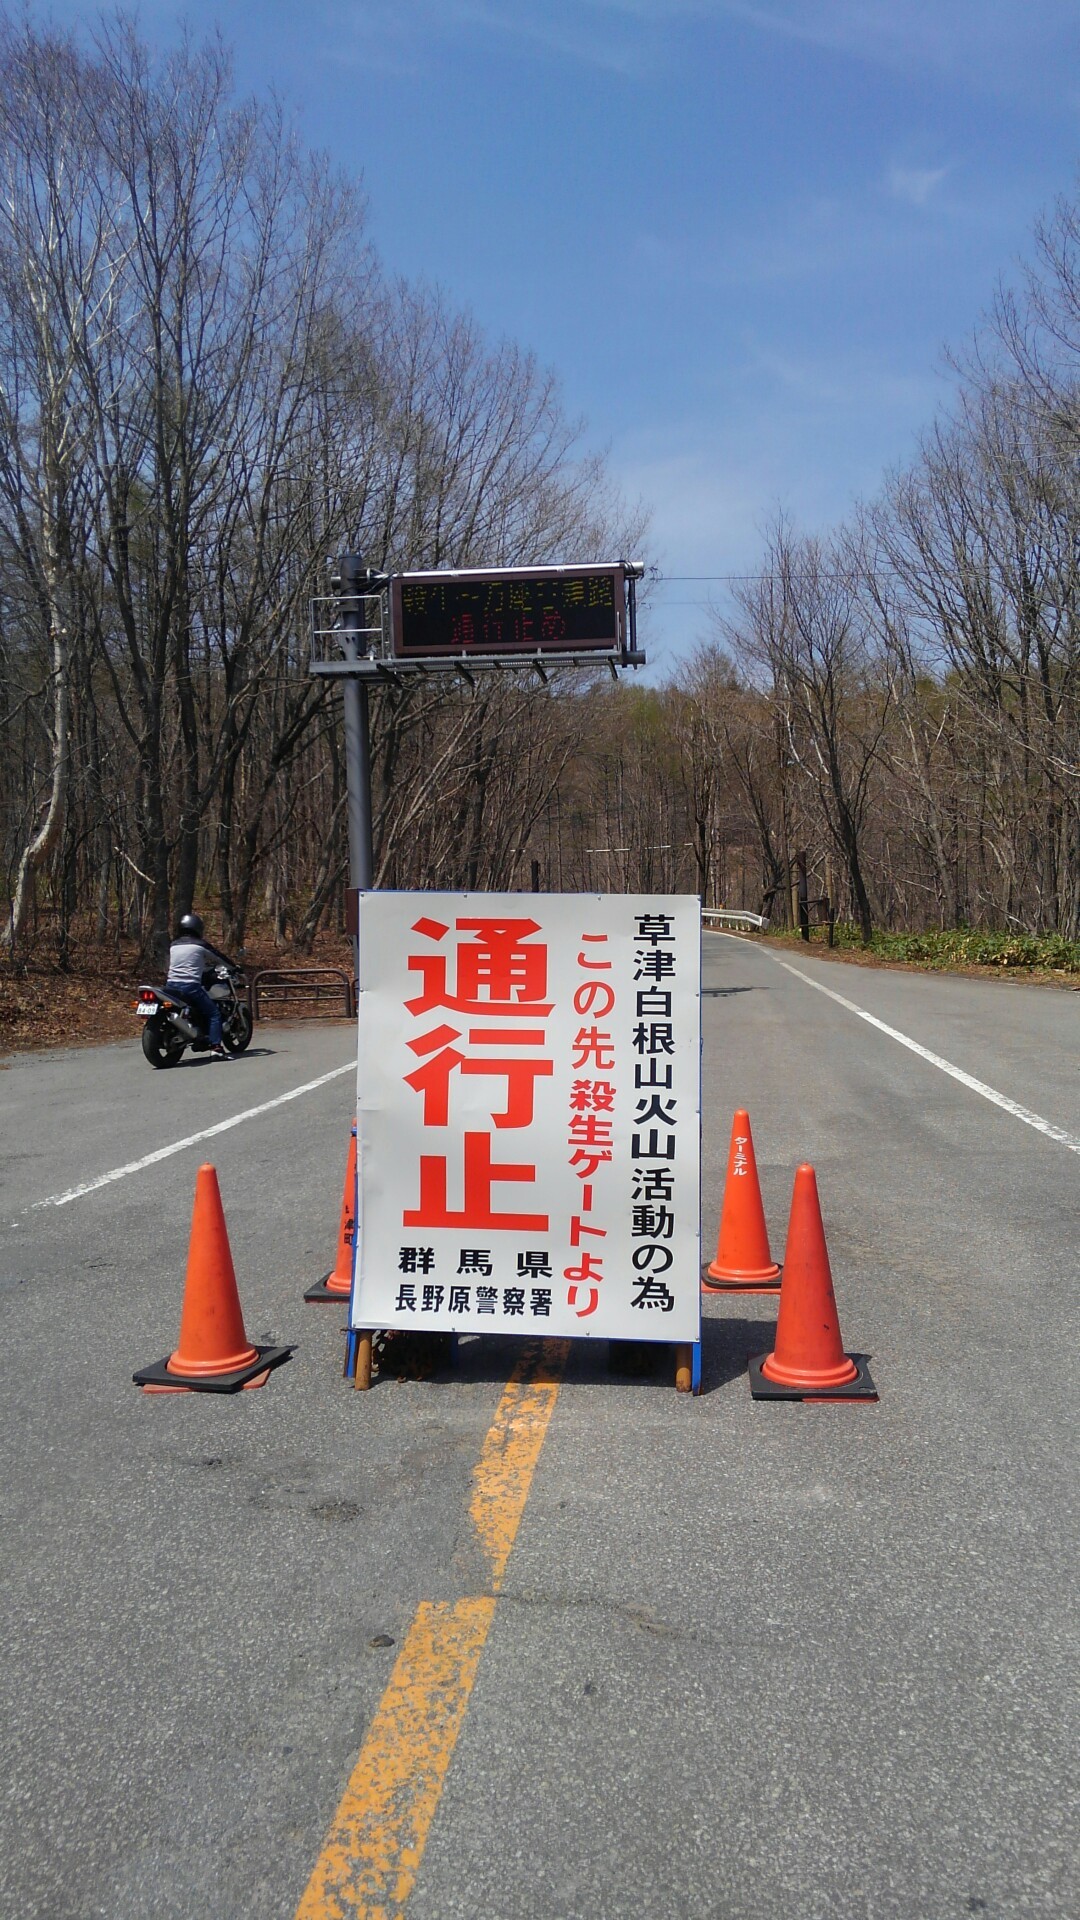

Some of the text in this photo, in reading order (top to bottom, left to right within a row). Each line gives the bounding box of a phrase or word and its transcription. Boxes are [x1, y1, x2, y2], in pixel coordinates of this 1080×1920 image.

[402, 916, 555, 1232] 通行止
[631, 913, 677, 1313] 草津白根山火山活動の為
[733, 1136, 748, 1176] ターミナル
[398, 1246, 553, 1279] 群馬県
[395, 1284, 553, 1317] 長野原警察署
